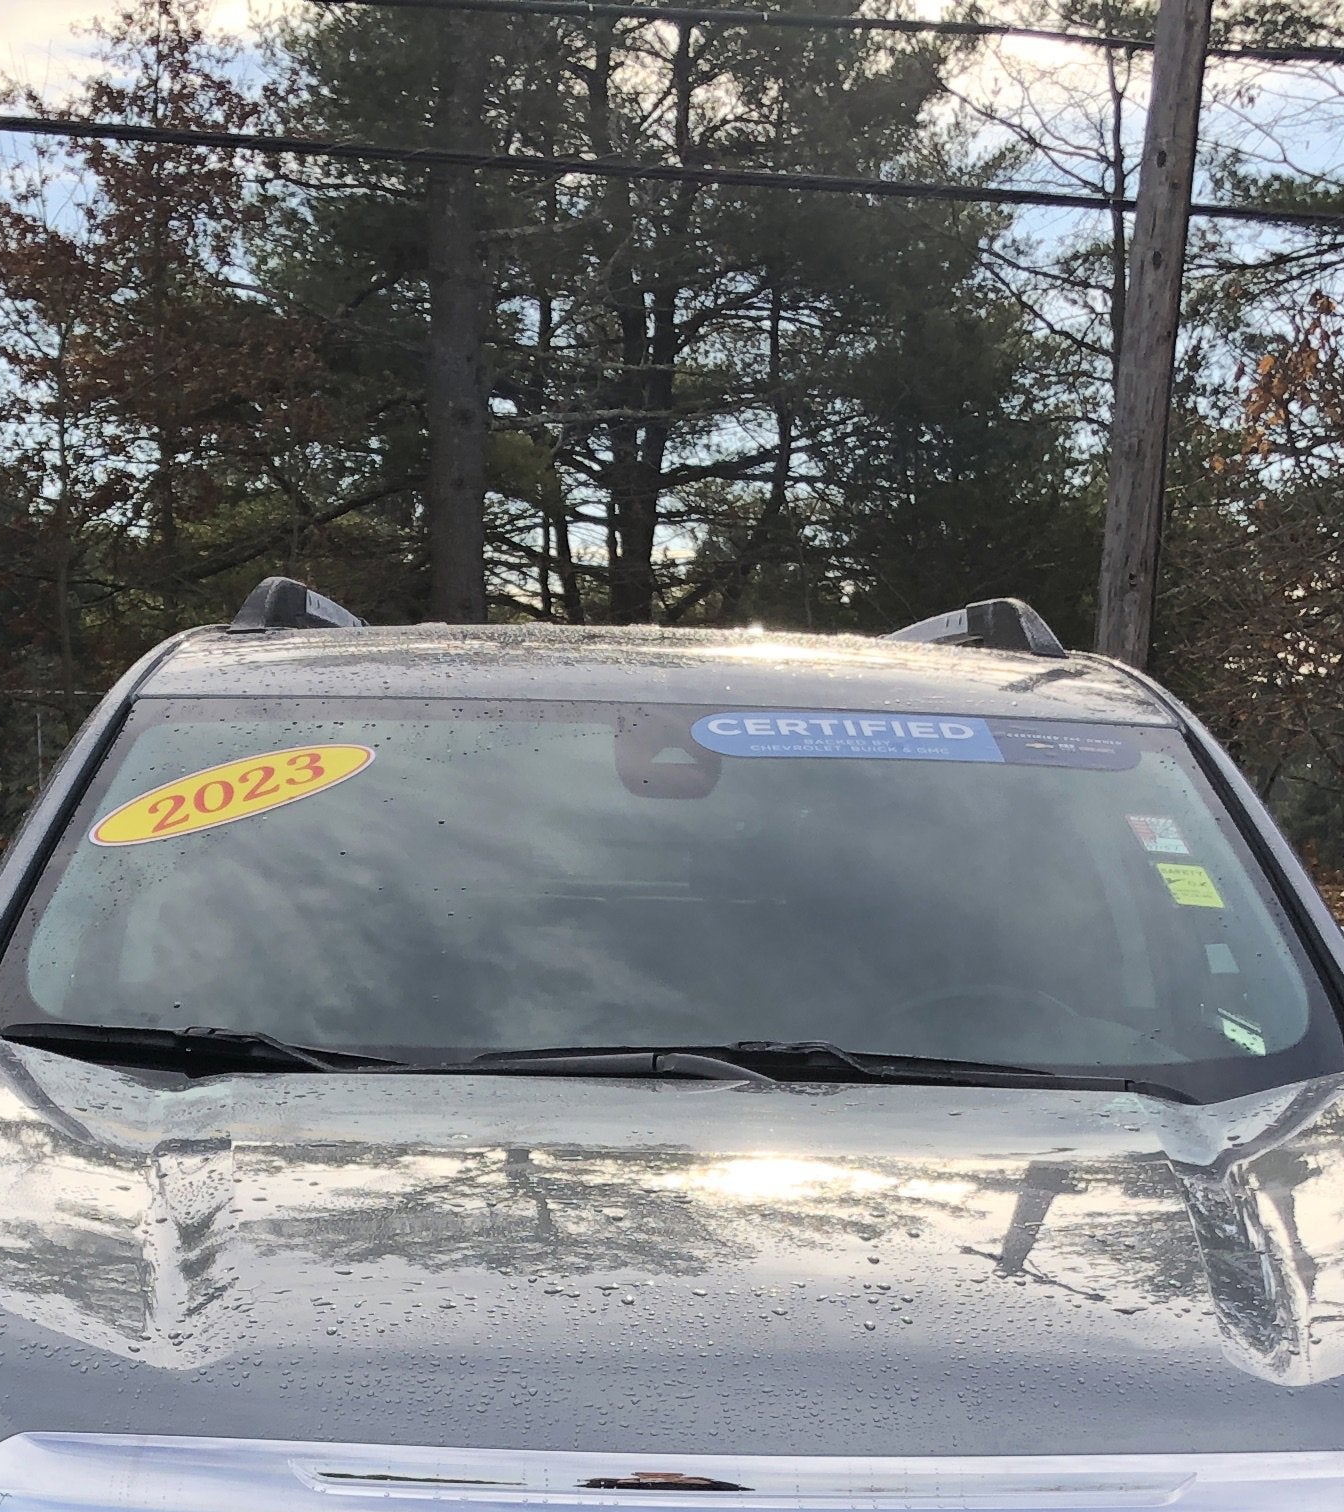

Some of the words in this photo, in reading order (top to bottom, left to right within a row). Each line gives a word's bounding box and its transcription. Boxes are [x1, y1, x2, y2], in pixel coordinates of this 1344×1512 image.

[707, 718, 975, 740] CERTIFIED
[749, 744, 841, 752] CHEVROLET
[850, 745, 897, 754] BUICK
[147, 752, 326, 834] 2023
